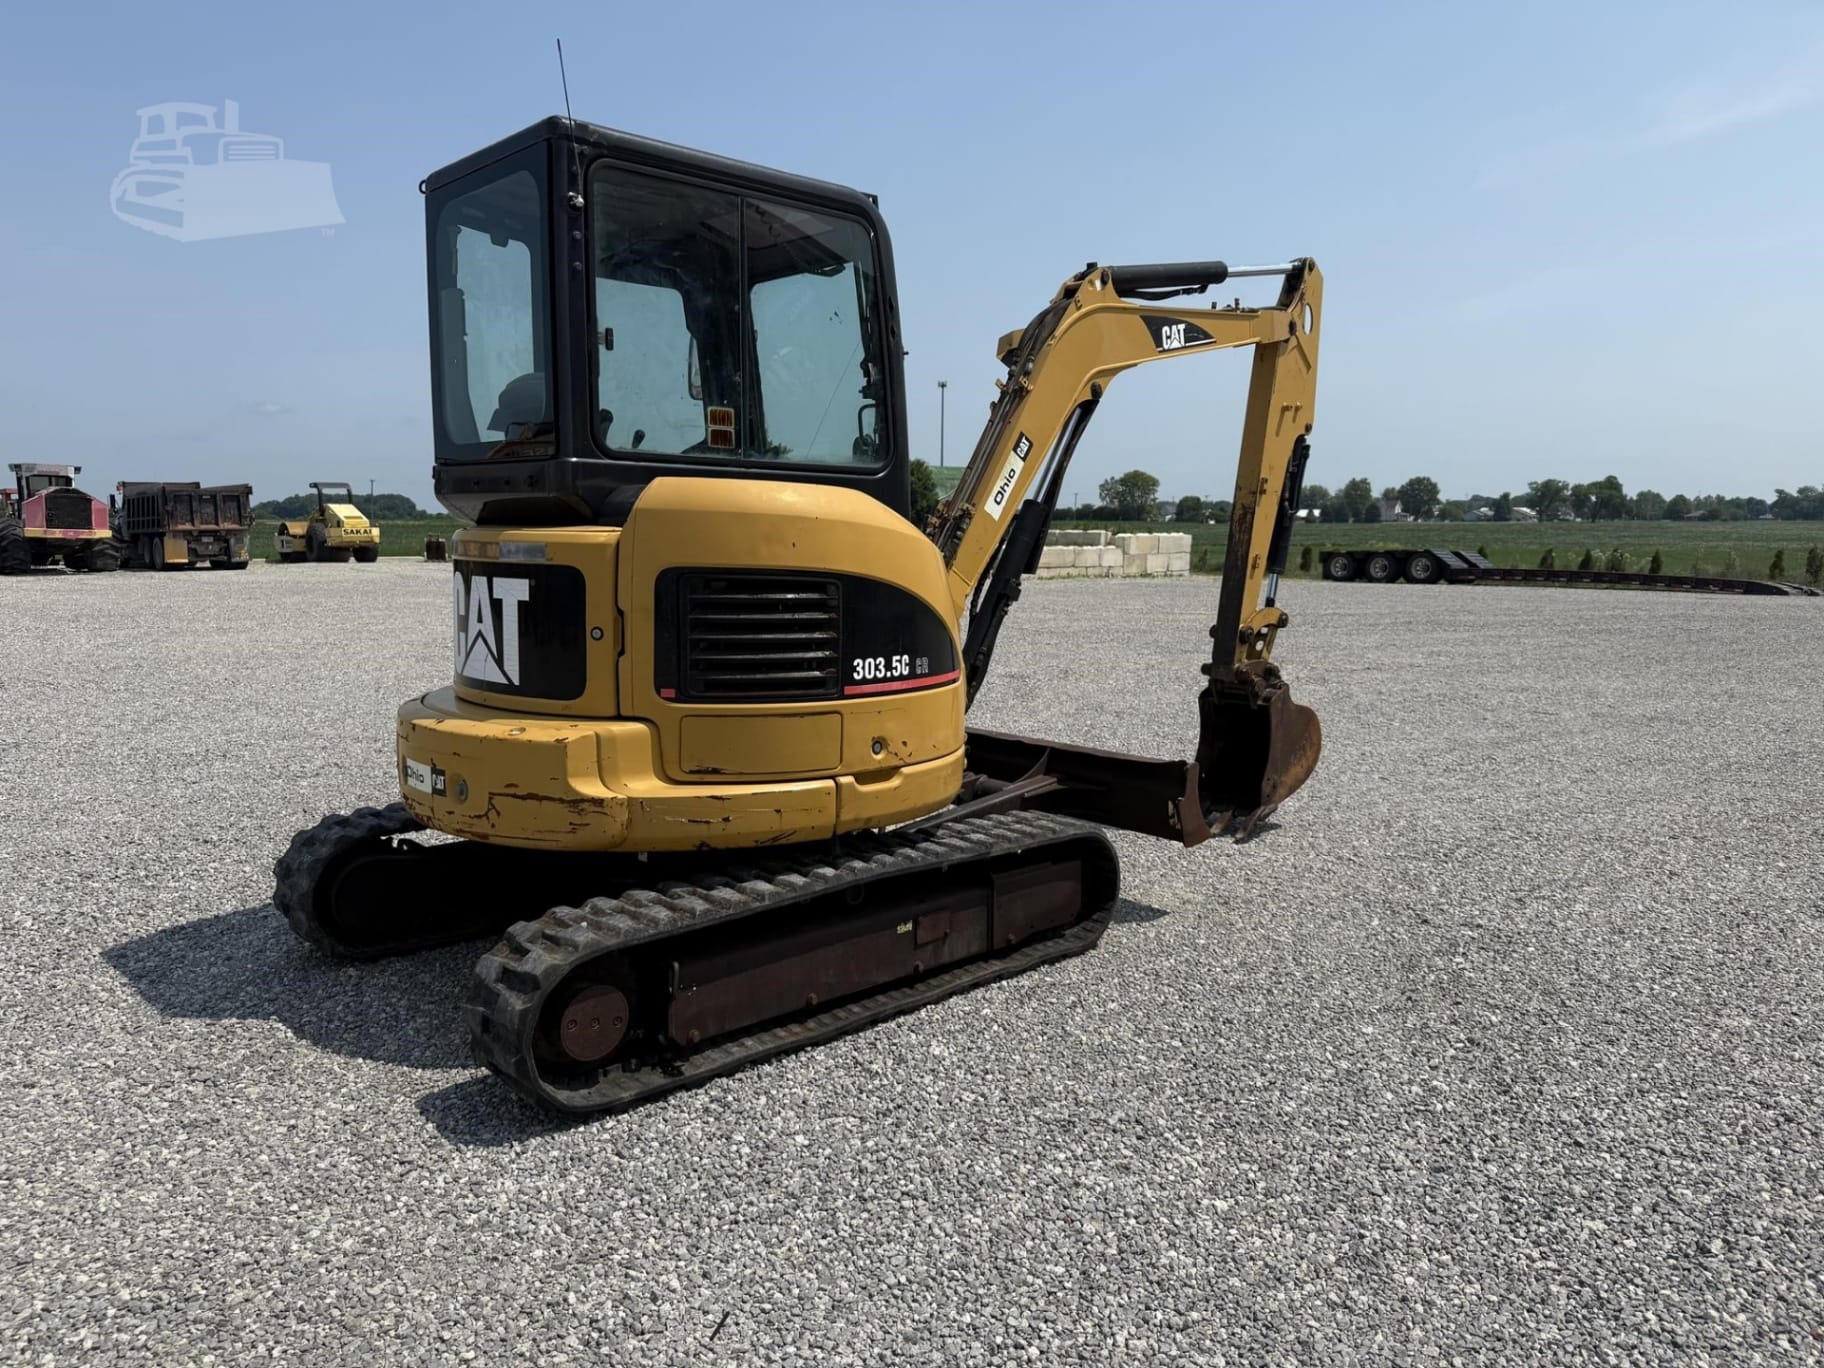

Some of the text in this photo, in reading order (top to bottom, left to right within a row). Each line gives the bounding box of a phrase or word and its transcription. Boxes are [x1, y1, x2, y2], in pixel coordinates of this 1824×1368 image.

[1161, 323, 1186, 350] CAT
[994, 435, 1031, 506] Ohio CAT
[343, 528, 373, 536] SAKAI
[454, 570, 530, 687] CAT
[852, 654, 910, 680] 303.5C
[405, 764, 446, 790] Ohio CAT
